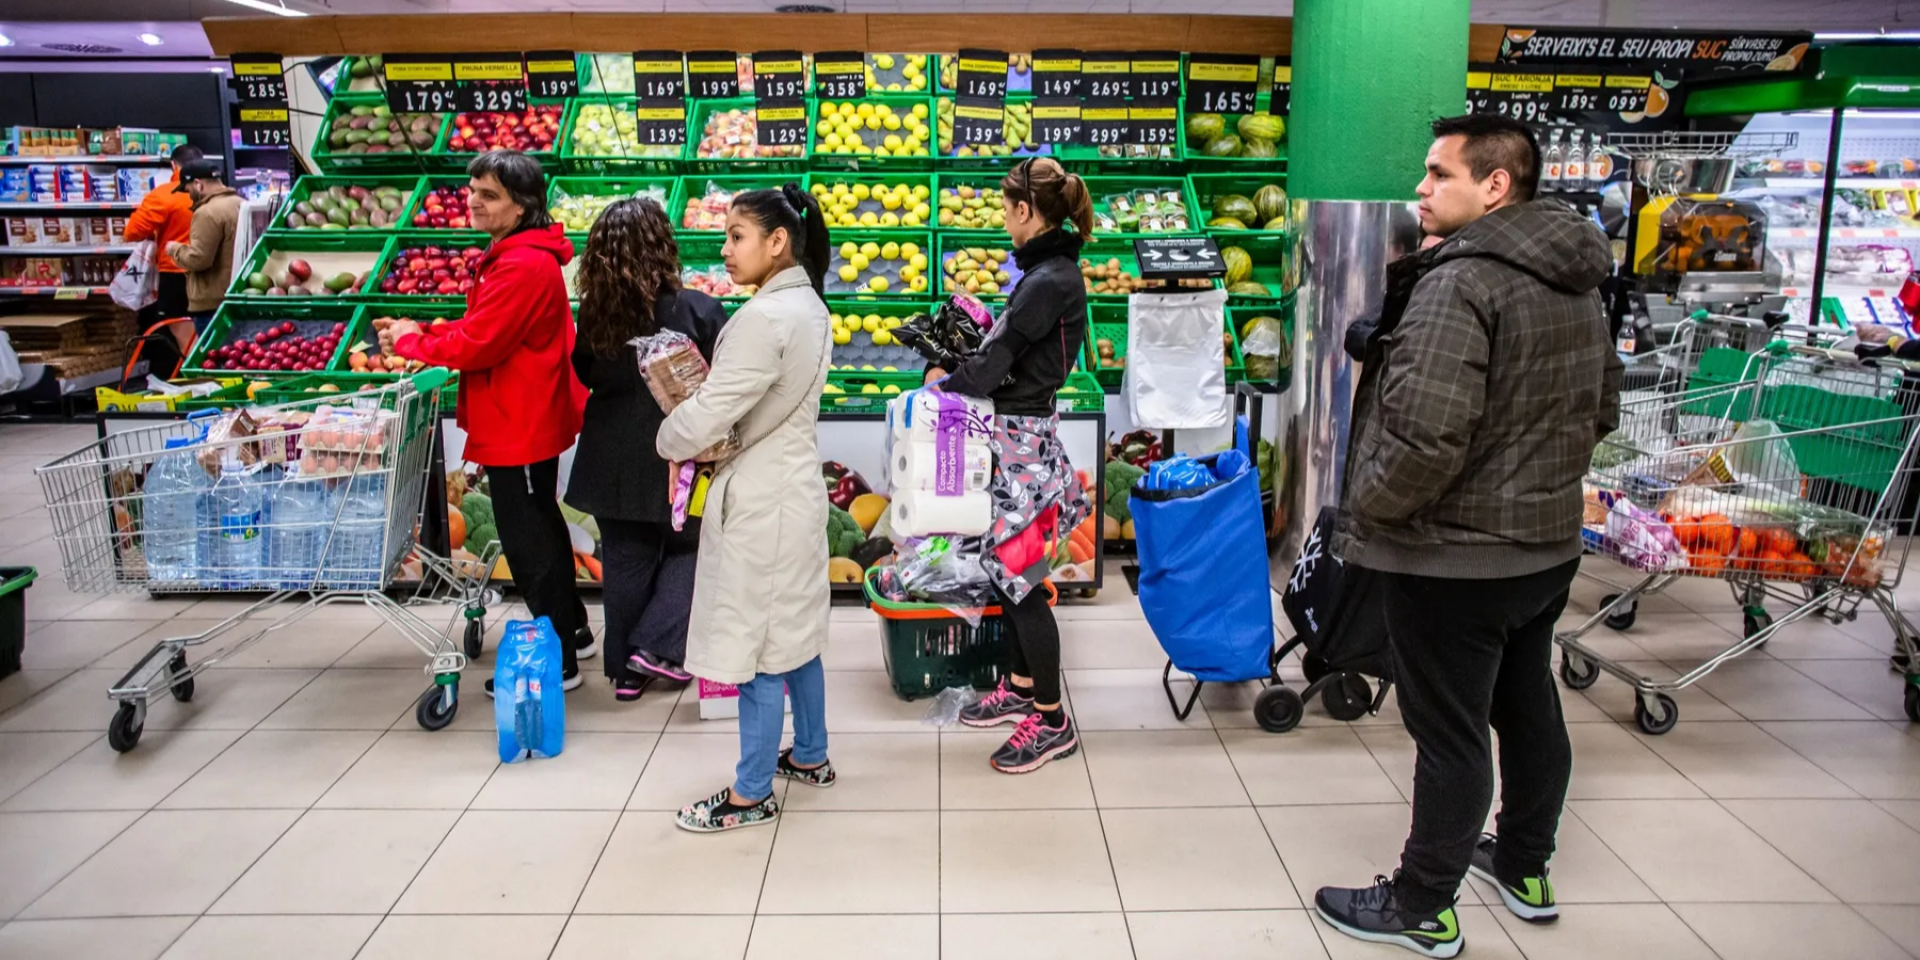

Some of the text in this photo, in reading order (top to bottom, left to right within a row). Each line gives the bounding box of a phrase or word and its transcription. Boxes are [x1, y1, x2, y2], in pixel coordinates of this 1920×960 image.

[1524, 37, 1727, 59] SERVEIXI'S EL SEU PROPI SUC
[1767, 40, 1783, 50] SU
[1720, 50, 1777, 62] PROPIO ZUMO
[1514, 75, 1552, 83] TARONJA
[938, 450, 948, 492] Compacto
[946, 435, 957, 492] Absorbente
